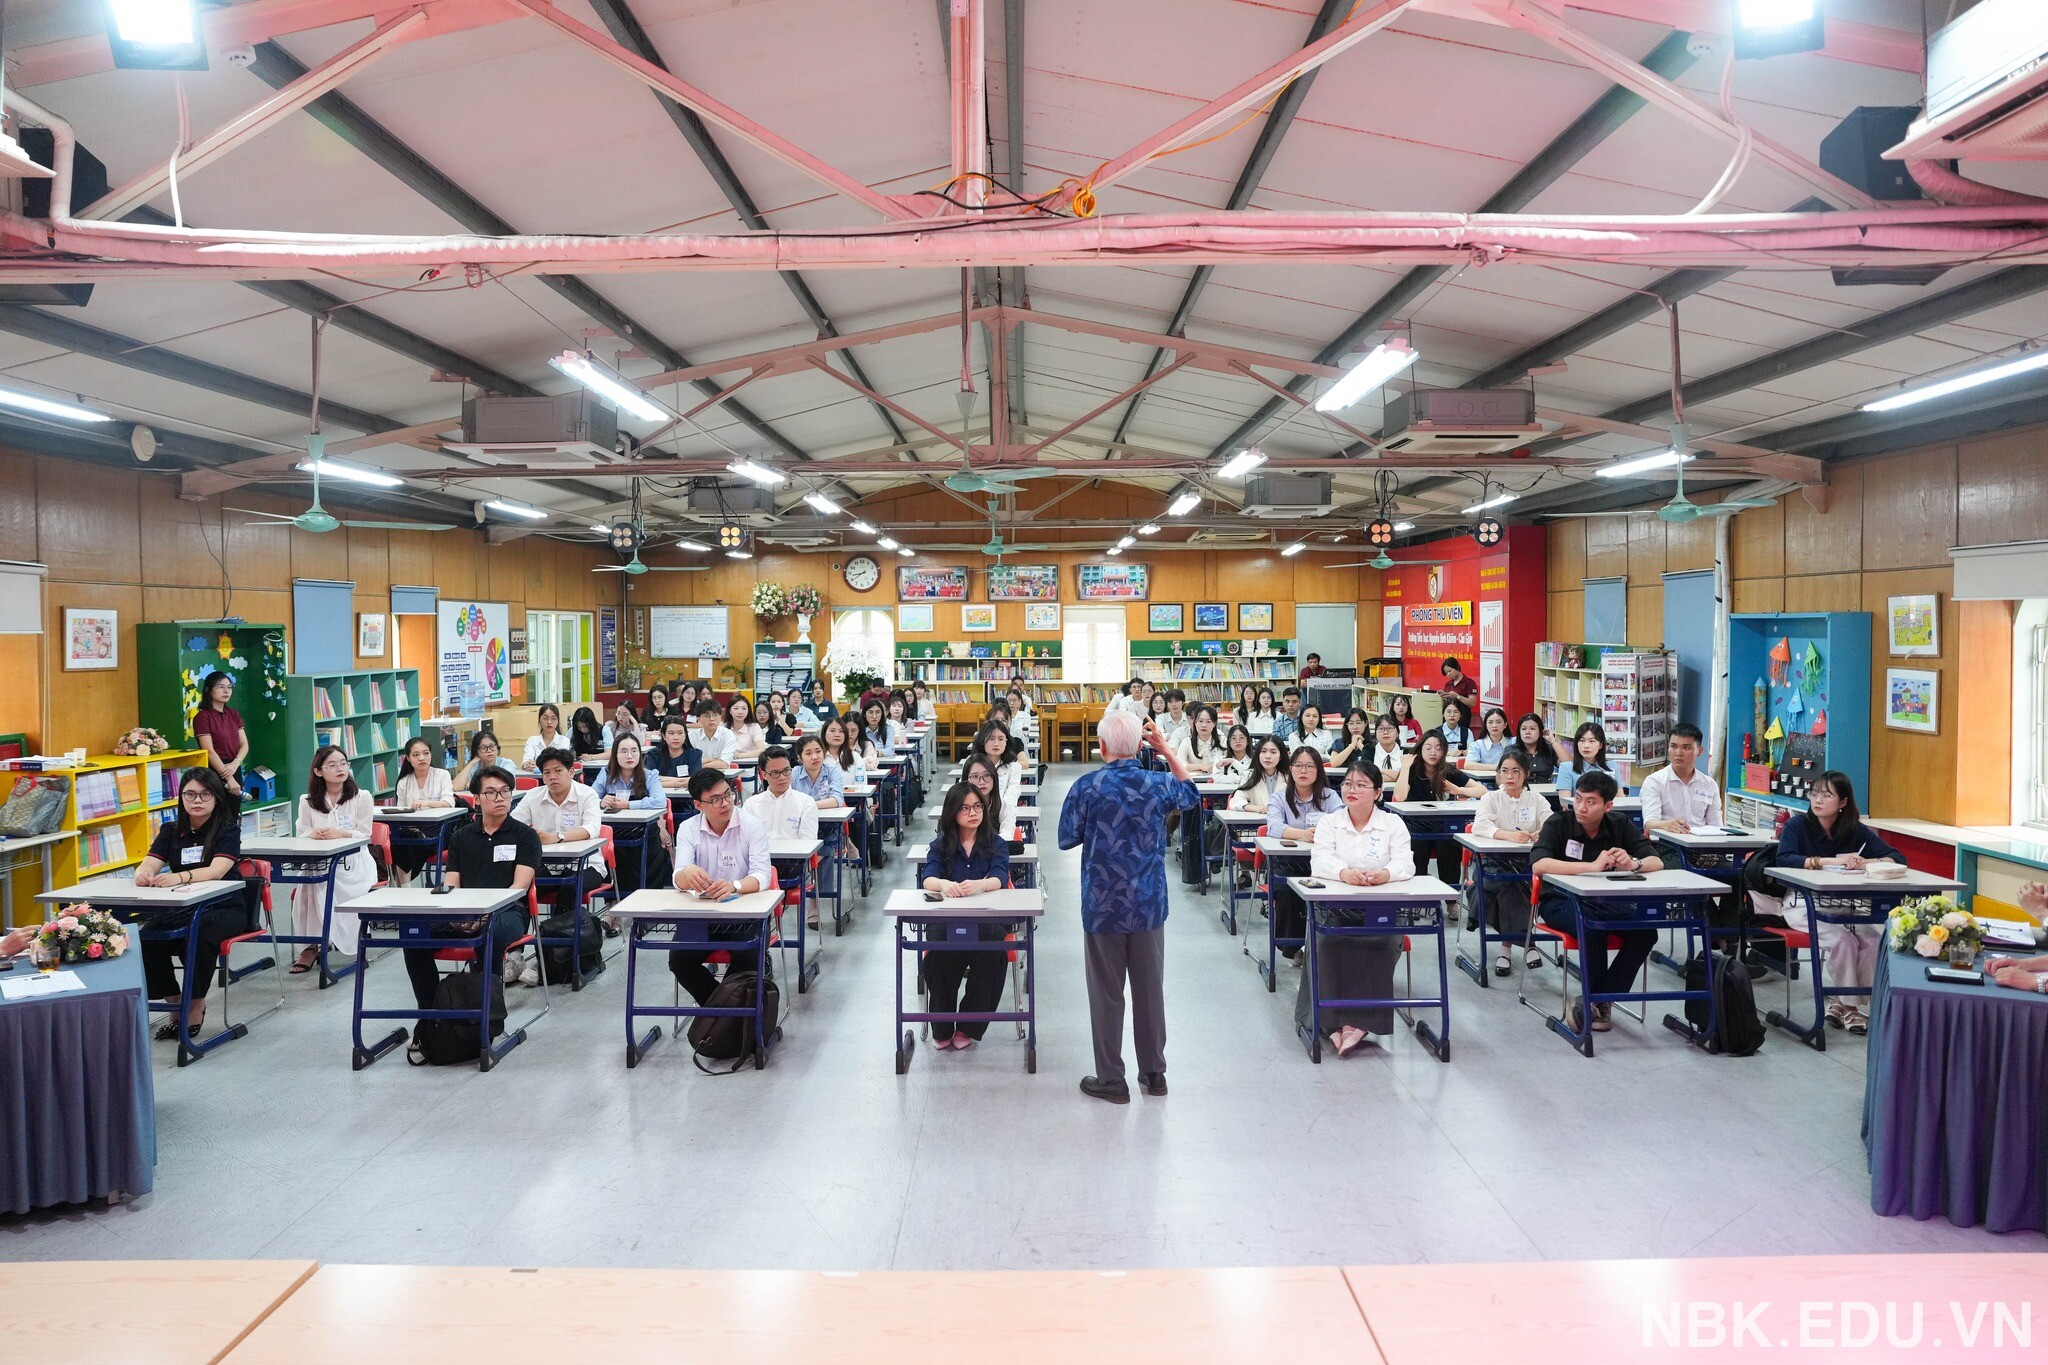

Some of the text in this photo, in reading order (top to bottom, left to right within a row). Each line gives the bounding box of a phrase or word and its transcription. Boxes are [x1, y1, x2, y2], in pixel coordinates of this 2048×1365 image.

[1412, 604, 1463, 623] PHÒNG THƯ VIỆN
